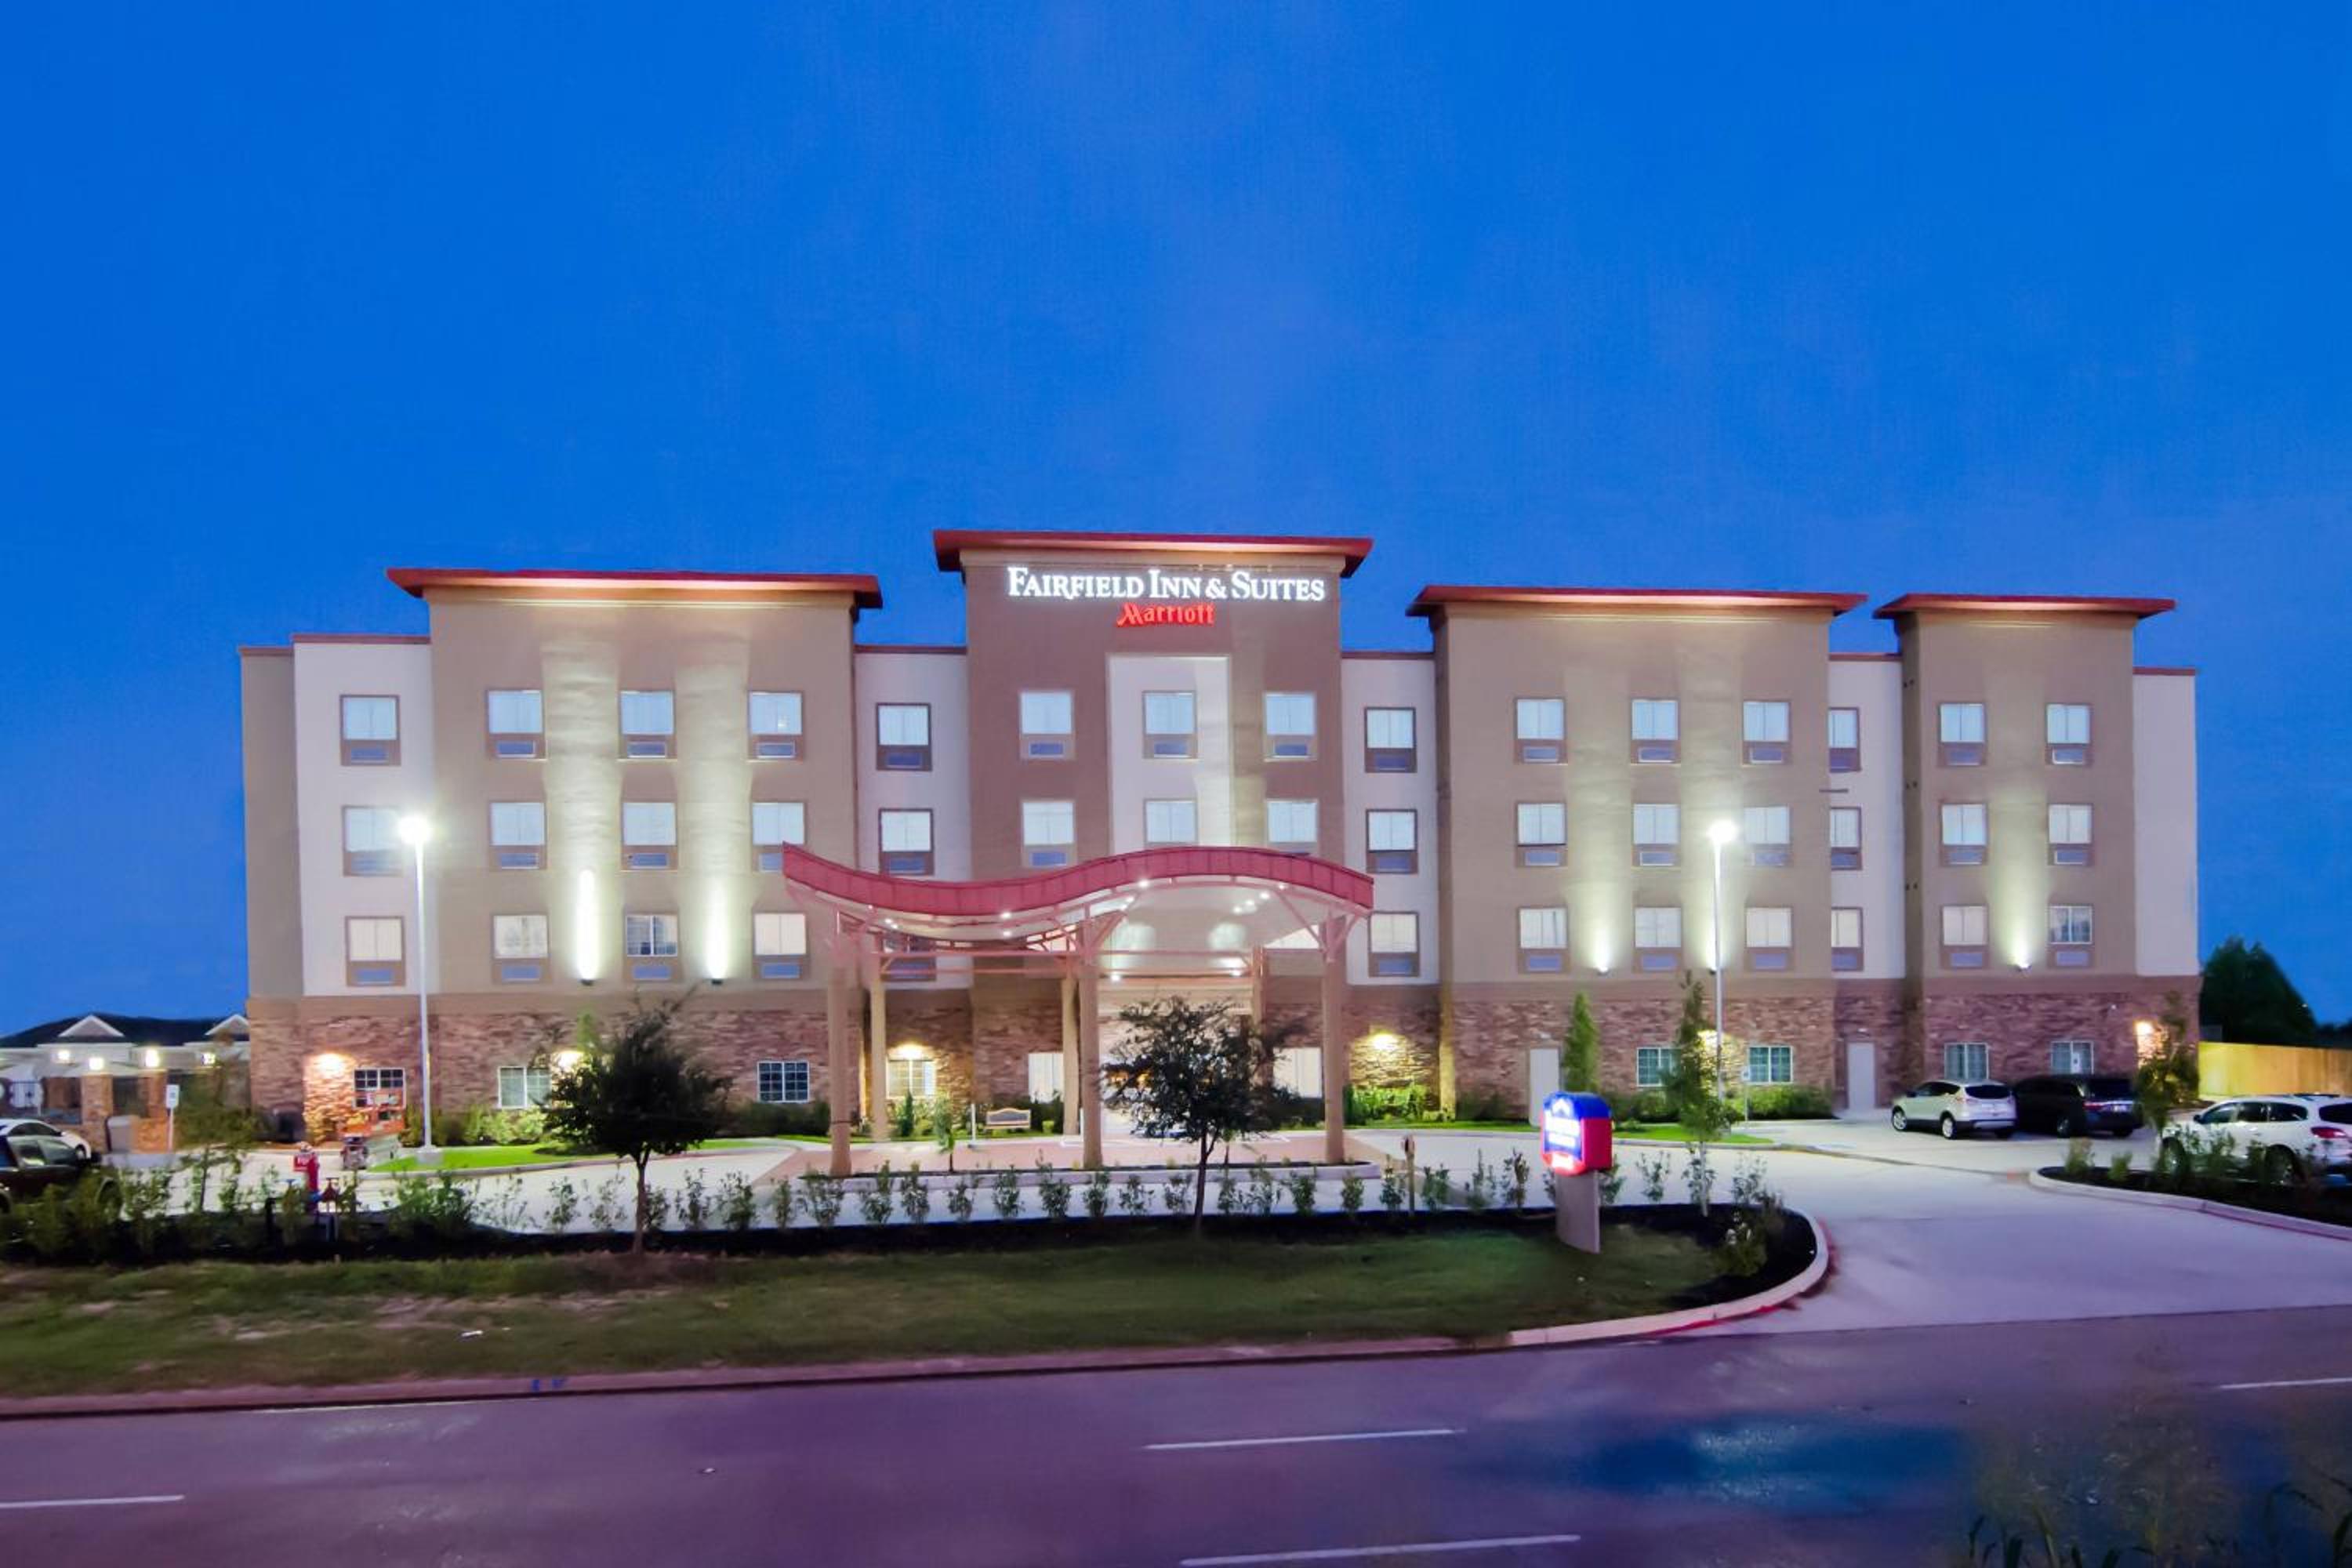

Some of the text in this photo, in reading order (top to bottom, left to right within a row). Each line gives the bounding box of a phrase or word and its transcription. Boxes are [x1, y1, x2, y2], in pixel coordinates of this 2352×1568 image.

[1007, 566, 1326, 601] FAIRFIELD INN & SUITES
[1116, 601, 1214, 626] Marriott
